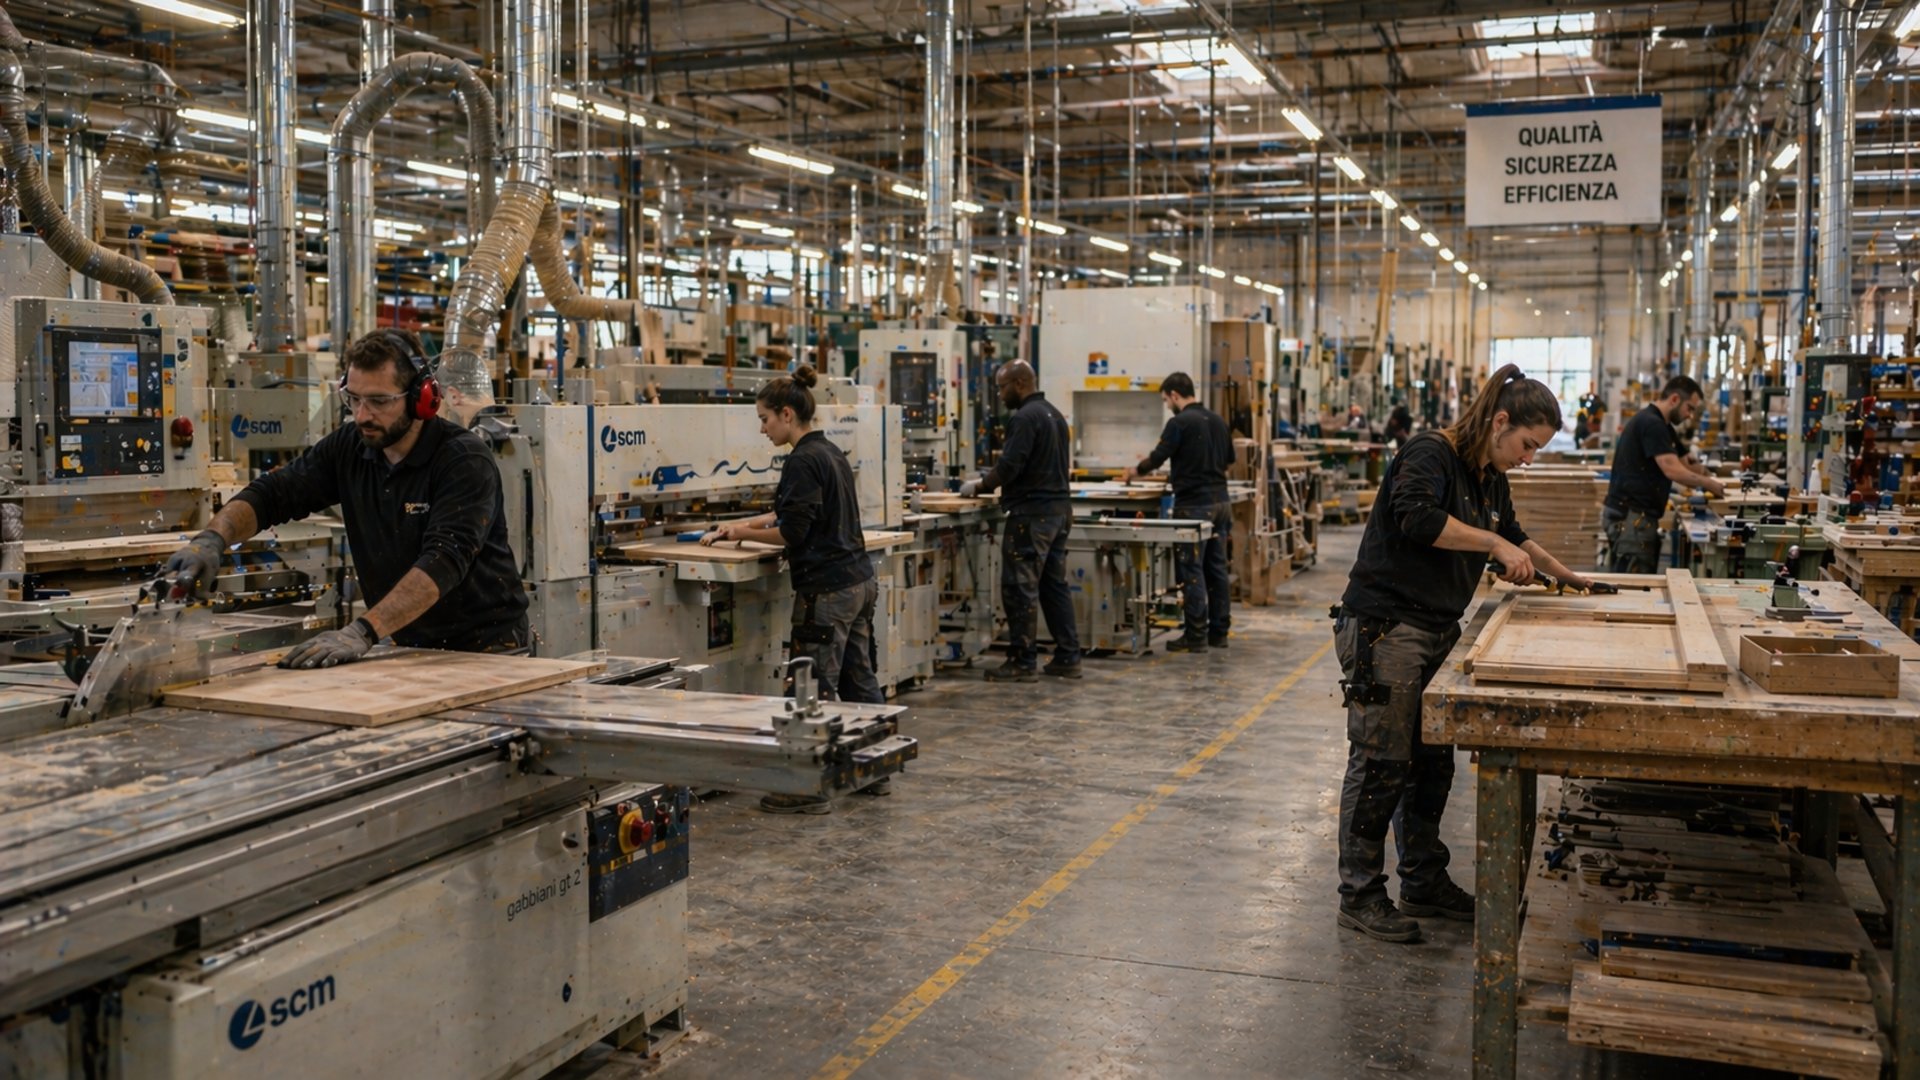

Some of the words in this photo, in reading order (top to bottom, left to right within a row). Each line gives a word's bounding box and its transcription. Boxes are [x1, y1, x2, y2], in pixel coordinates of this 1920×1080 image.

[1518, 120, 1603, 147] QUALITÀ
[1505, 153, 1617, 175] SICUREZZA
[1504, 182, 1618, 203] EFFICIENZA
[250, 420, 282, 434] scm
[617, 430, 646, 446] scm
[507, 878, 557, 922] gabbiani
[559, 873, 572, 897] gt
[574, 868, 582, 886] 2
[270, 974, 335, 1027] scm
